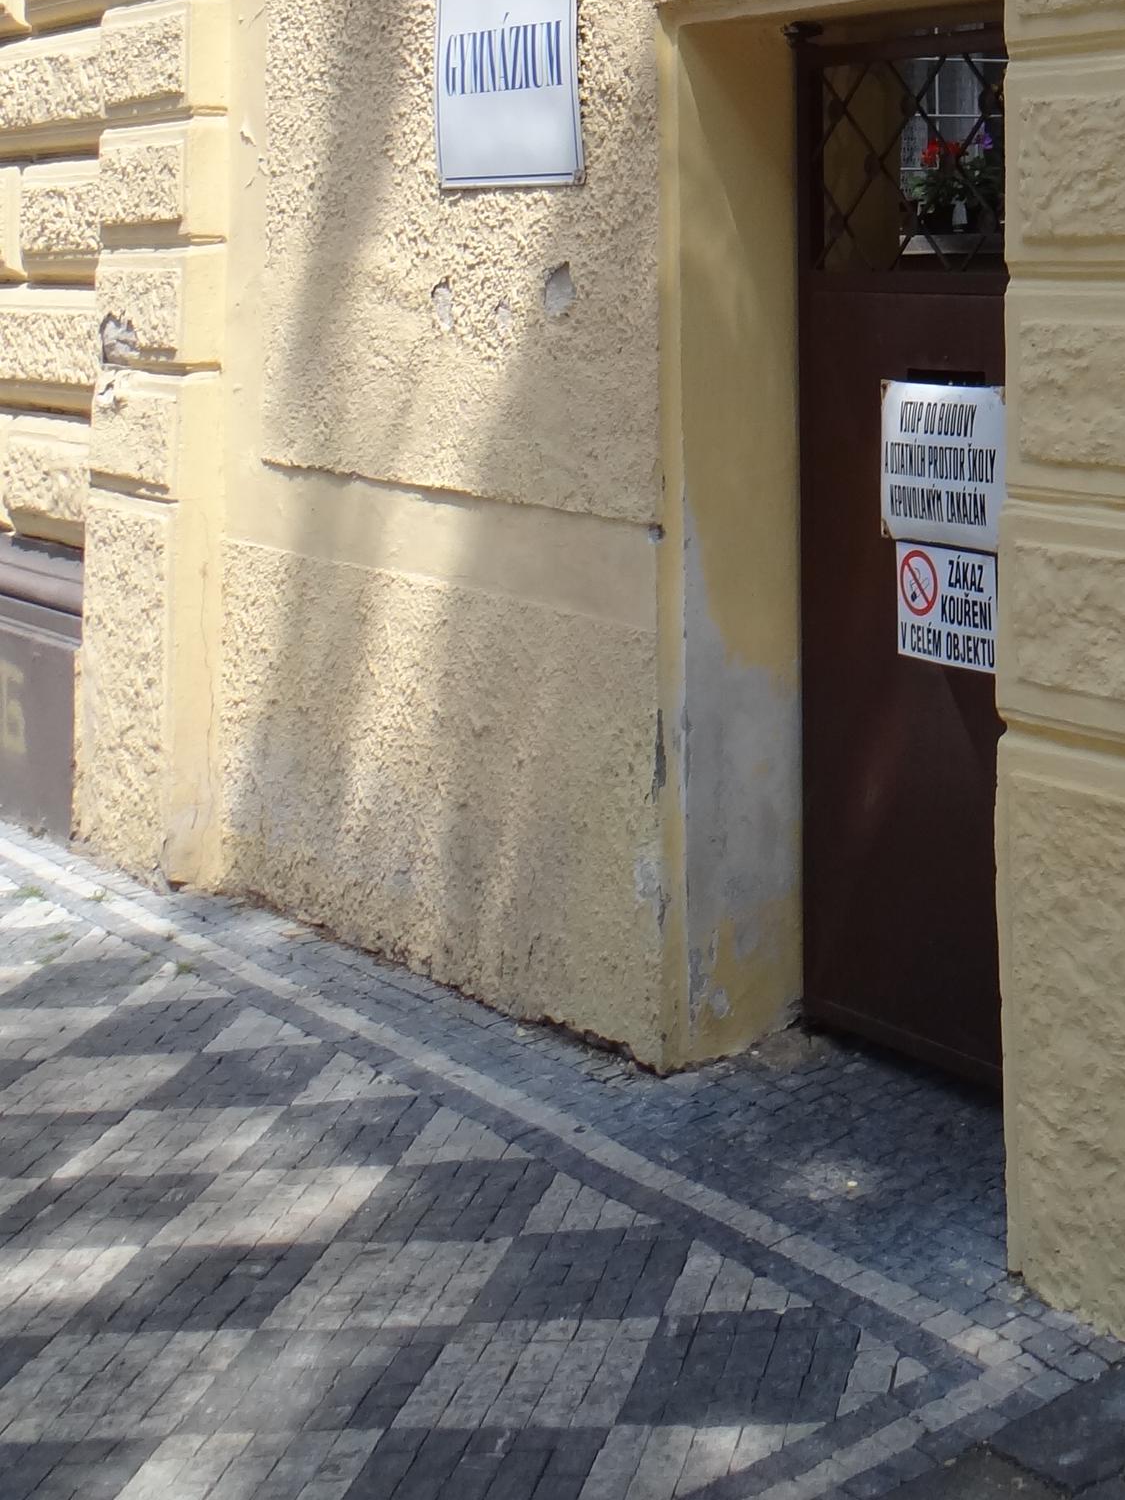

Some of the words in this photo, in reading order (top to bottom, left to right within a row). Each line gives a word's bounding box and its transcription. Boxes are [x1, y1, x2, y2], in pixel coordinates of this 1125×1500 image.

[445, 11, 563, 97] GYMNÁZIUM
[900, 401, 924, 433] VSTUP
[924, 402, 938, 435] DO
[938, 403, 977, 438] BUDOVY
[890, 438, 926, 478] OSTATNÍCH
[928, 445, 965, 481] PROSTOR
[967, 442, 996, 484] ŠKOLY
[890, 483, 944, 522] NEPOVOLANÝM
[945, 486, 987, 526] ZAKÁZÁN
[948, 555, 984, 593] ZÁKAZ
[941, 593, 992, 631] KOUŘENÍ
[901, 621, 907, 649] V
[910, 622, 942, 658] CELÉM
[946, 631, 995, 668] OBJEKTU
